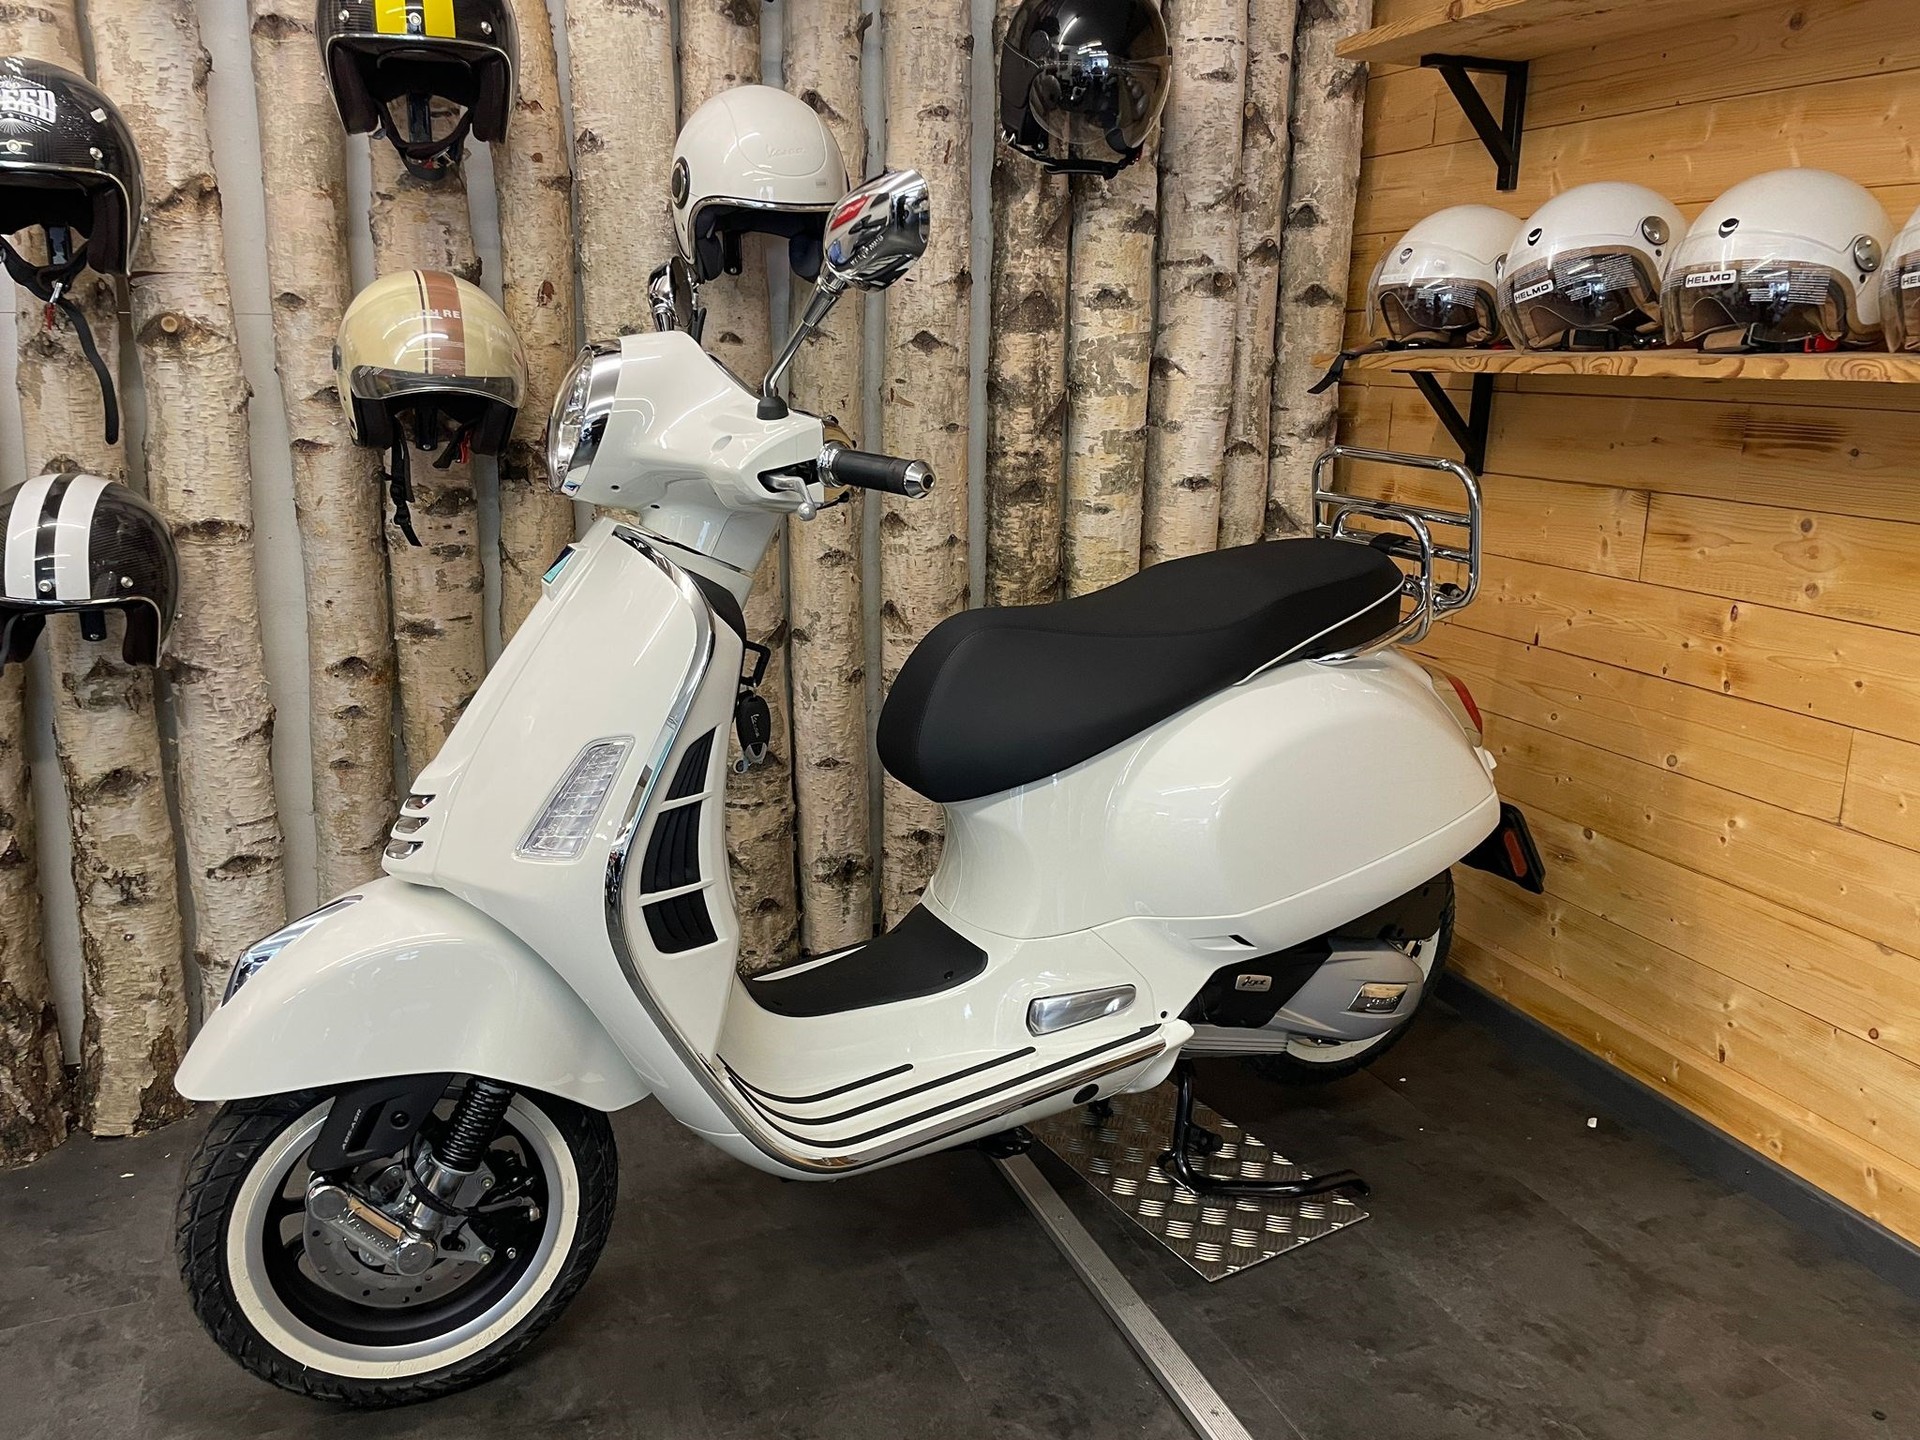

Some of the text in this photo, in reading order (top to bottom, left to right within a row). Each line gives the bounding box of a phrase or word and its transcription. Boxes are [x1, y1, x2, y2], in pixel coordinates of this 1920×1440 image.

[0, 88, 56, 123] EED
[1687, 273, 1733, 285] HELMO
[1514, 283, 1551, 301] HELMO
